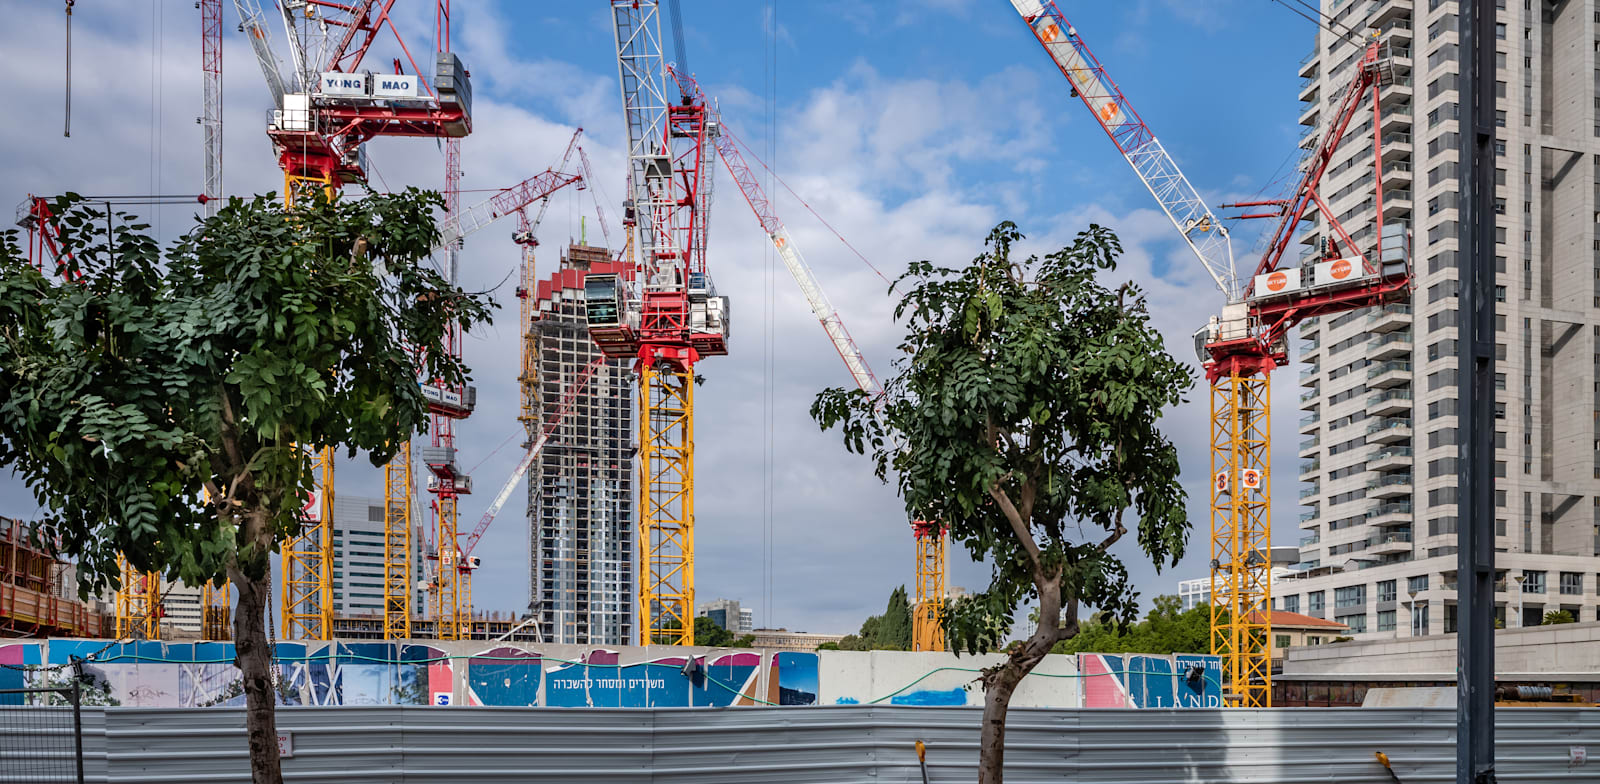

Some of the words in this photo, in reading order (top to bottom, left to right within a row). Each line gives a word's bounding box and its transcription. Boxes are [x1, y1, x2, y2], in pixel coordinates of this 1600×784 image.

[326, 79, 361, 89] YONG
[382, 81, 409, 90] MAO
[423, 389, 439, 397] YONG
[445, 394, 458, 402] MAO
[1248, 473, 1255, 484] 8
[596, 679, 626, 689] ומסחר
[629, 679, 664, 689] משרדים
